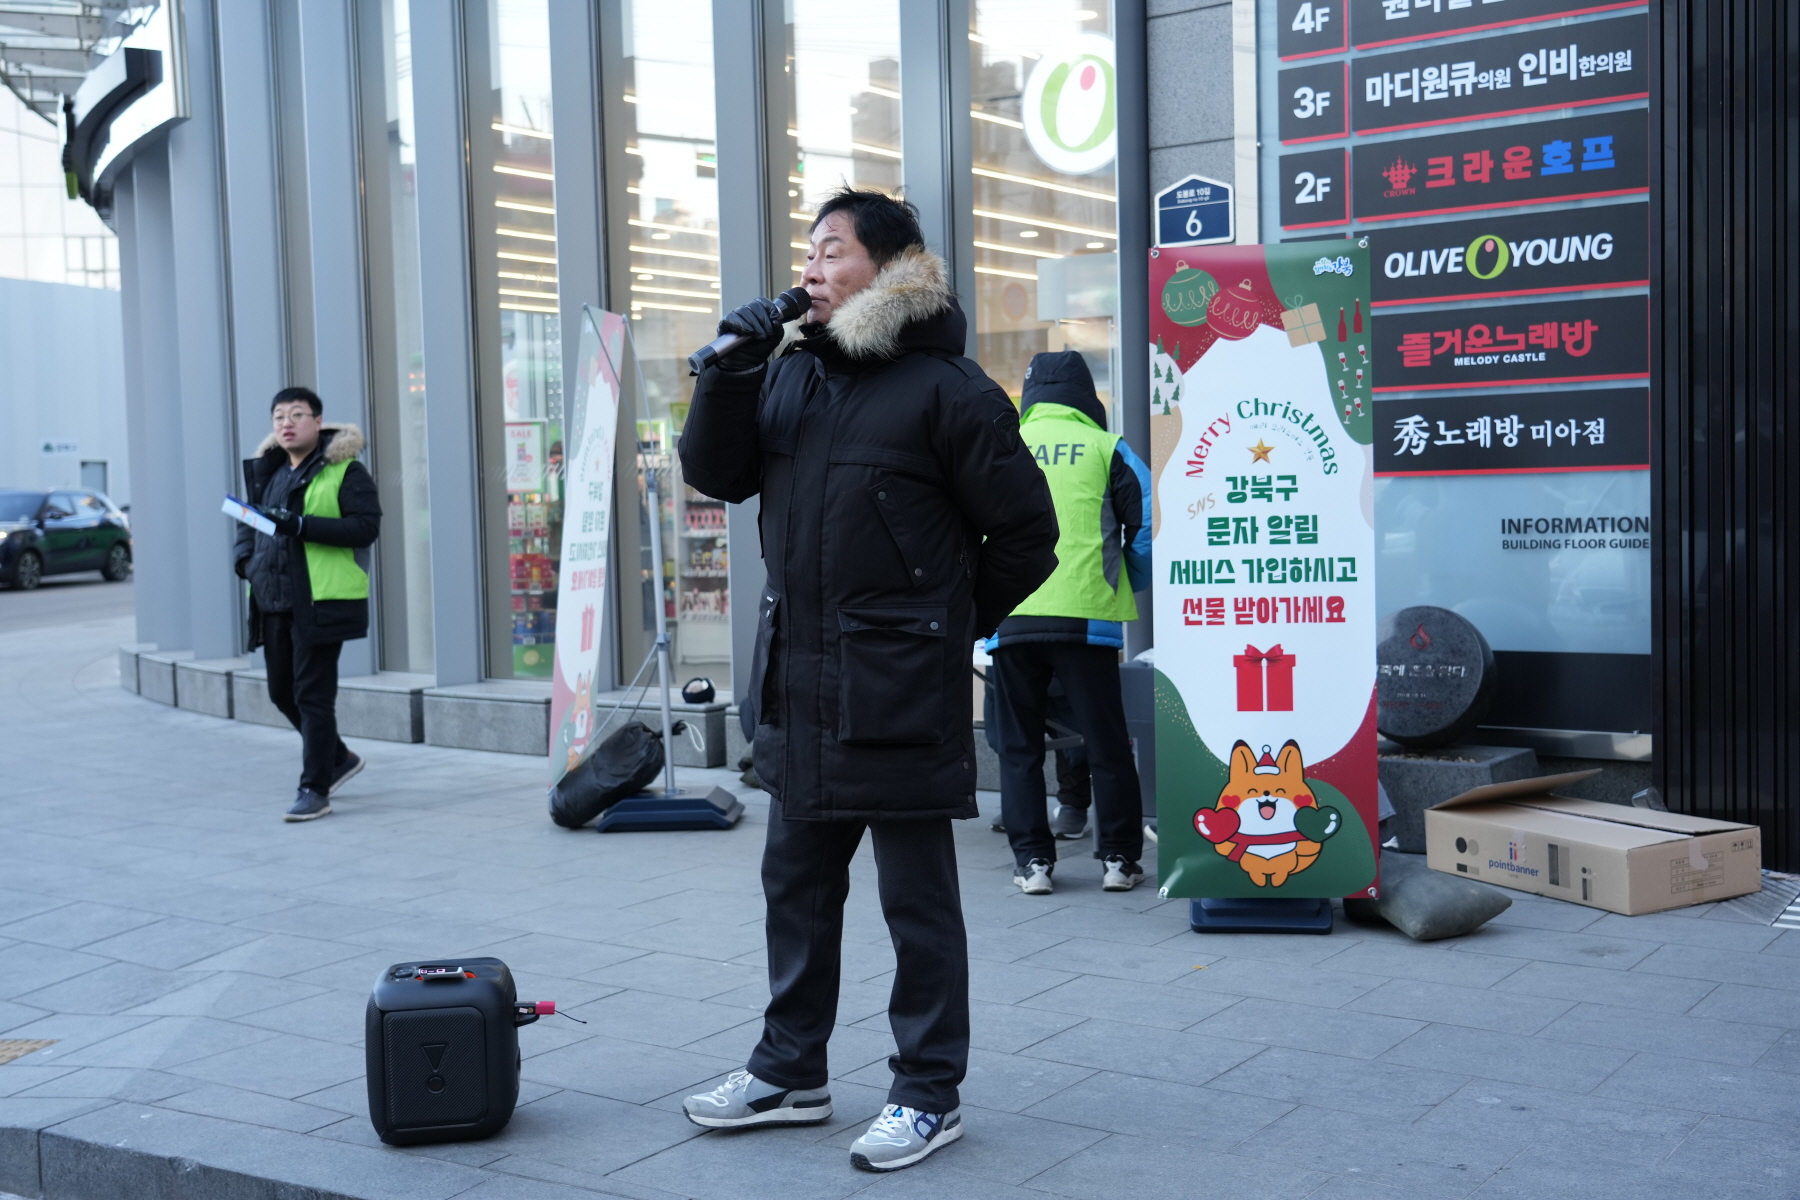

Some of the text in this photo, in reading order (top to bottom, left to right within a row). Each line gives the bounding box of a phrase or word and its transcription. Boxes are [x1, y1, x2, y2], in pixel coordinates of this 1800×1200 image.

[1291, 3, 1330, 34] 4F
[1518, 44, 1633, 87] 인비한의원
[1293, 86, 1331, 119] 3F
[1294, 171, 1331, 204] 2F
[1383, 187, 1416, 198] CROWN
[1185, 209, 1203, 237] 6
[1383, 246, 1465, 280] OLIVE
[1508, 232, 1614, 269] YOUNG
[1453, 352, 1547, 367] MELODY CASTLE
[1184, 397, 1339, 479] Merry Christmas
[1530, 417, 1605, 448] 미아점
[1225, 475, 1298, 504] 강북구
[1187, 492, 1216, 520] SNS
[1207, 514, 1319, 546] 문자 알림
[1501, 516, 1650, 535] INFORMATION
[1502, 538, 1650, 550] BUILDING FLOOR GUIDE
[1169, 557, 1358, 585] 서비스 가입하시고
[1182, 595, 1346, 626] 선물 받아가세요
[1488, 859, 1540, 877] pointbanner
